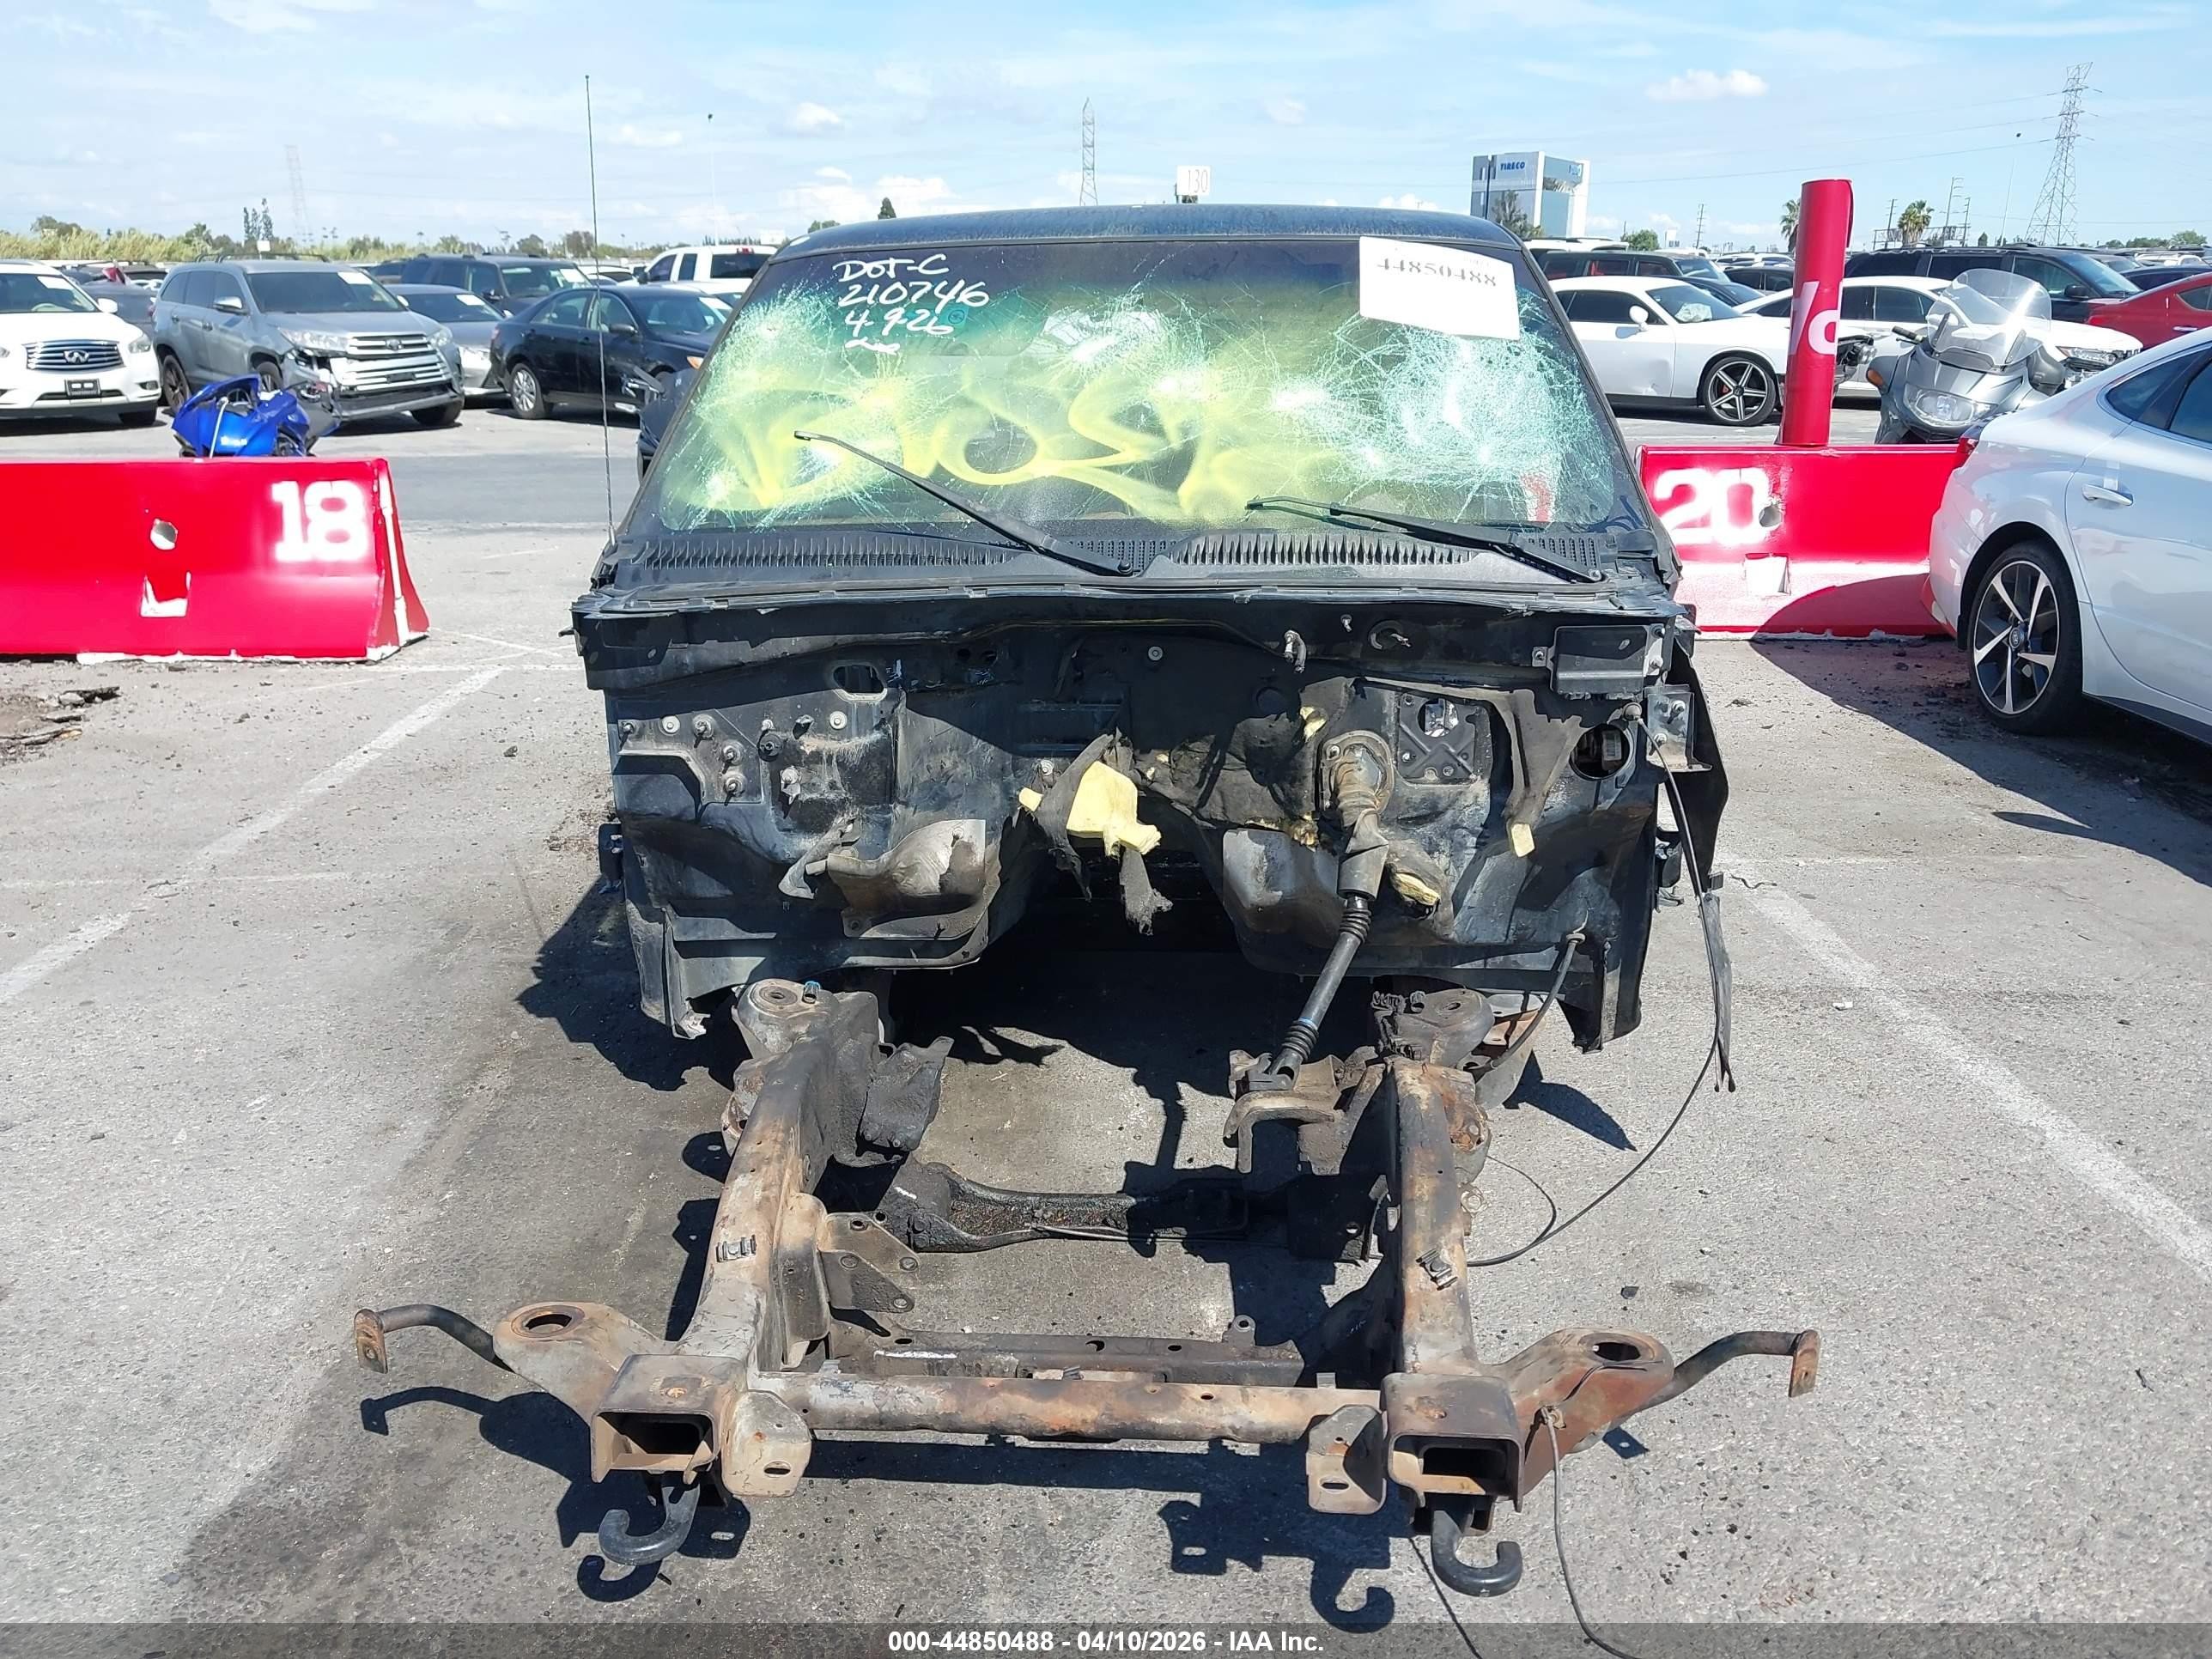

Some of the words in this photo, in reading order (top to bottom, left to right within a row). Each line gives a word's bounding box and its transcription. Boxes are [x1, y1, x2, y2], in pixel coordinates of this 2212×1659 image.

[1499, 161, 1526, 172] TIRECO
[1376, 258, 1497, 288] 44850488
[838, 279, 990, 314] 210746
[271, 480, 368, 562] 18
[1654, 467, 1772, 546] 20
